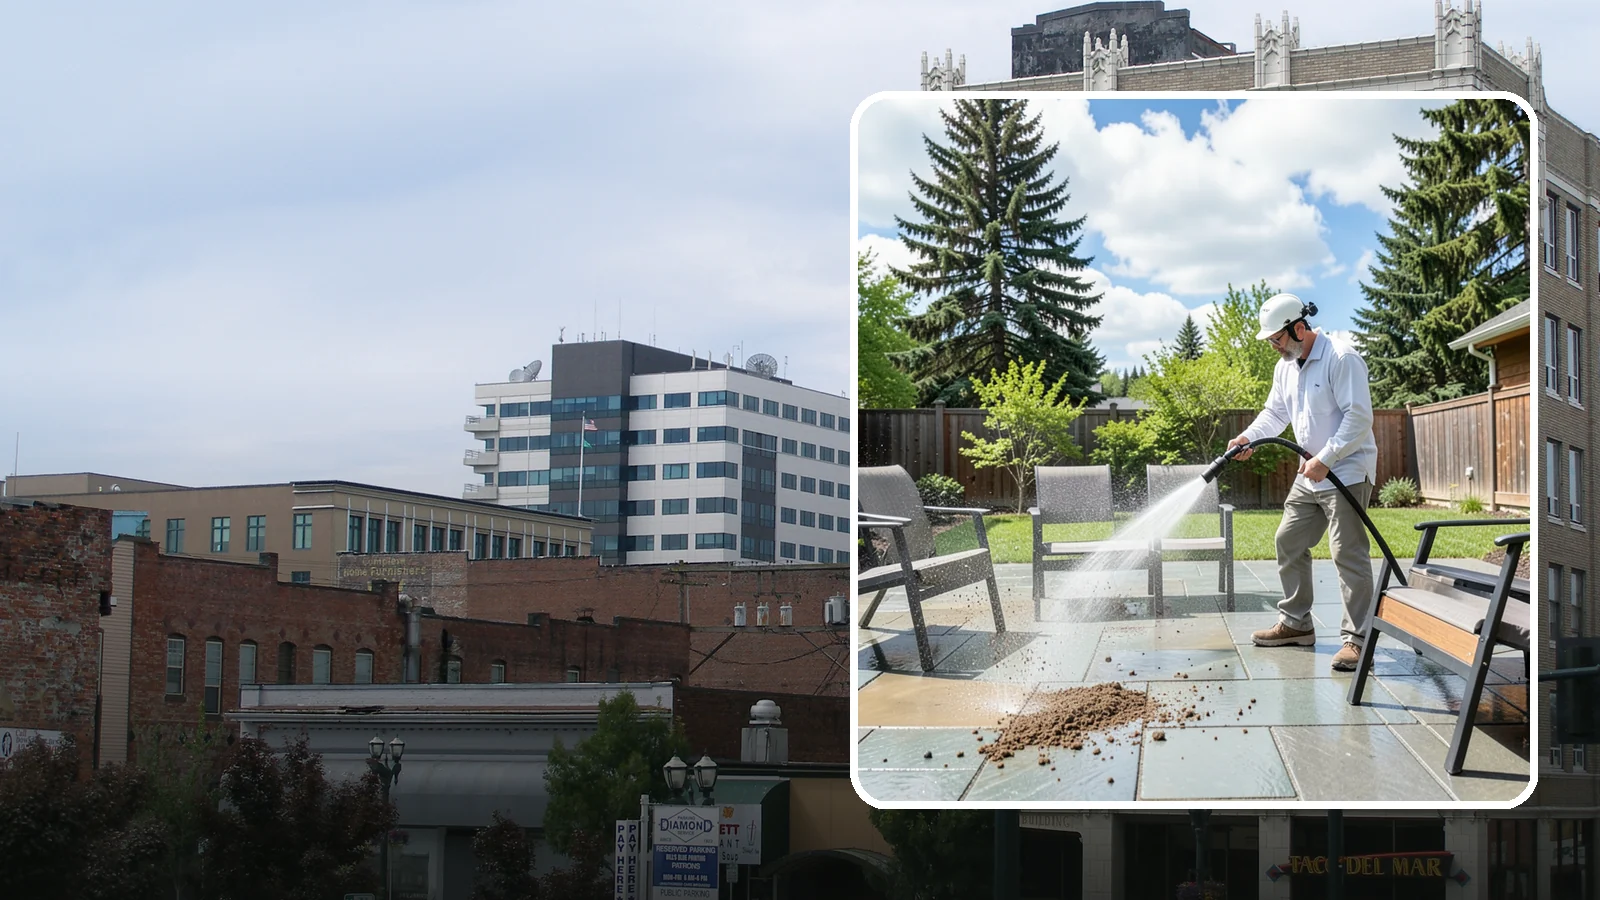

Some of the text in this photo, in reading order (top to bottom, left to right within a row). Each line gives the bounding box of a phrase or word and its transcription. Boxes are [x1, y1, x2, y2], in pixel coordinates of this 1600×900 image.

[660, 818, 713, 833] DIAMOND
[1021, 815, 1071, 828] BUILDING
[656, 845, 716, 854] RESERVED PARKING
[616, 824, 625, 894] PAY HERE
[627, 824, 637, 893] PAY HERE
[671, 862, 701, 870] PATRONS
[1346, 856, 1384, 875] DEL
[1393, 857, 1443, 876] MAR
[660, 888, 710, 899] PUBLIC PARKING
